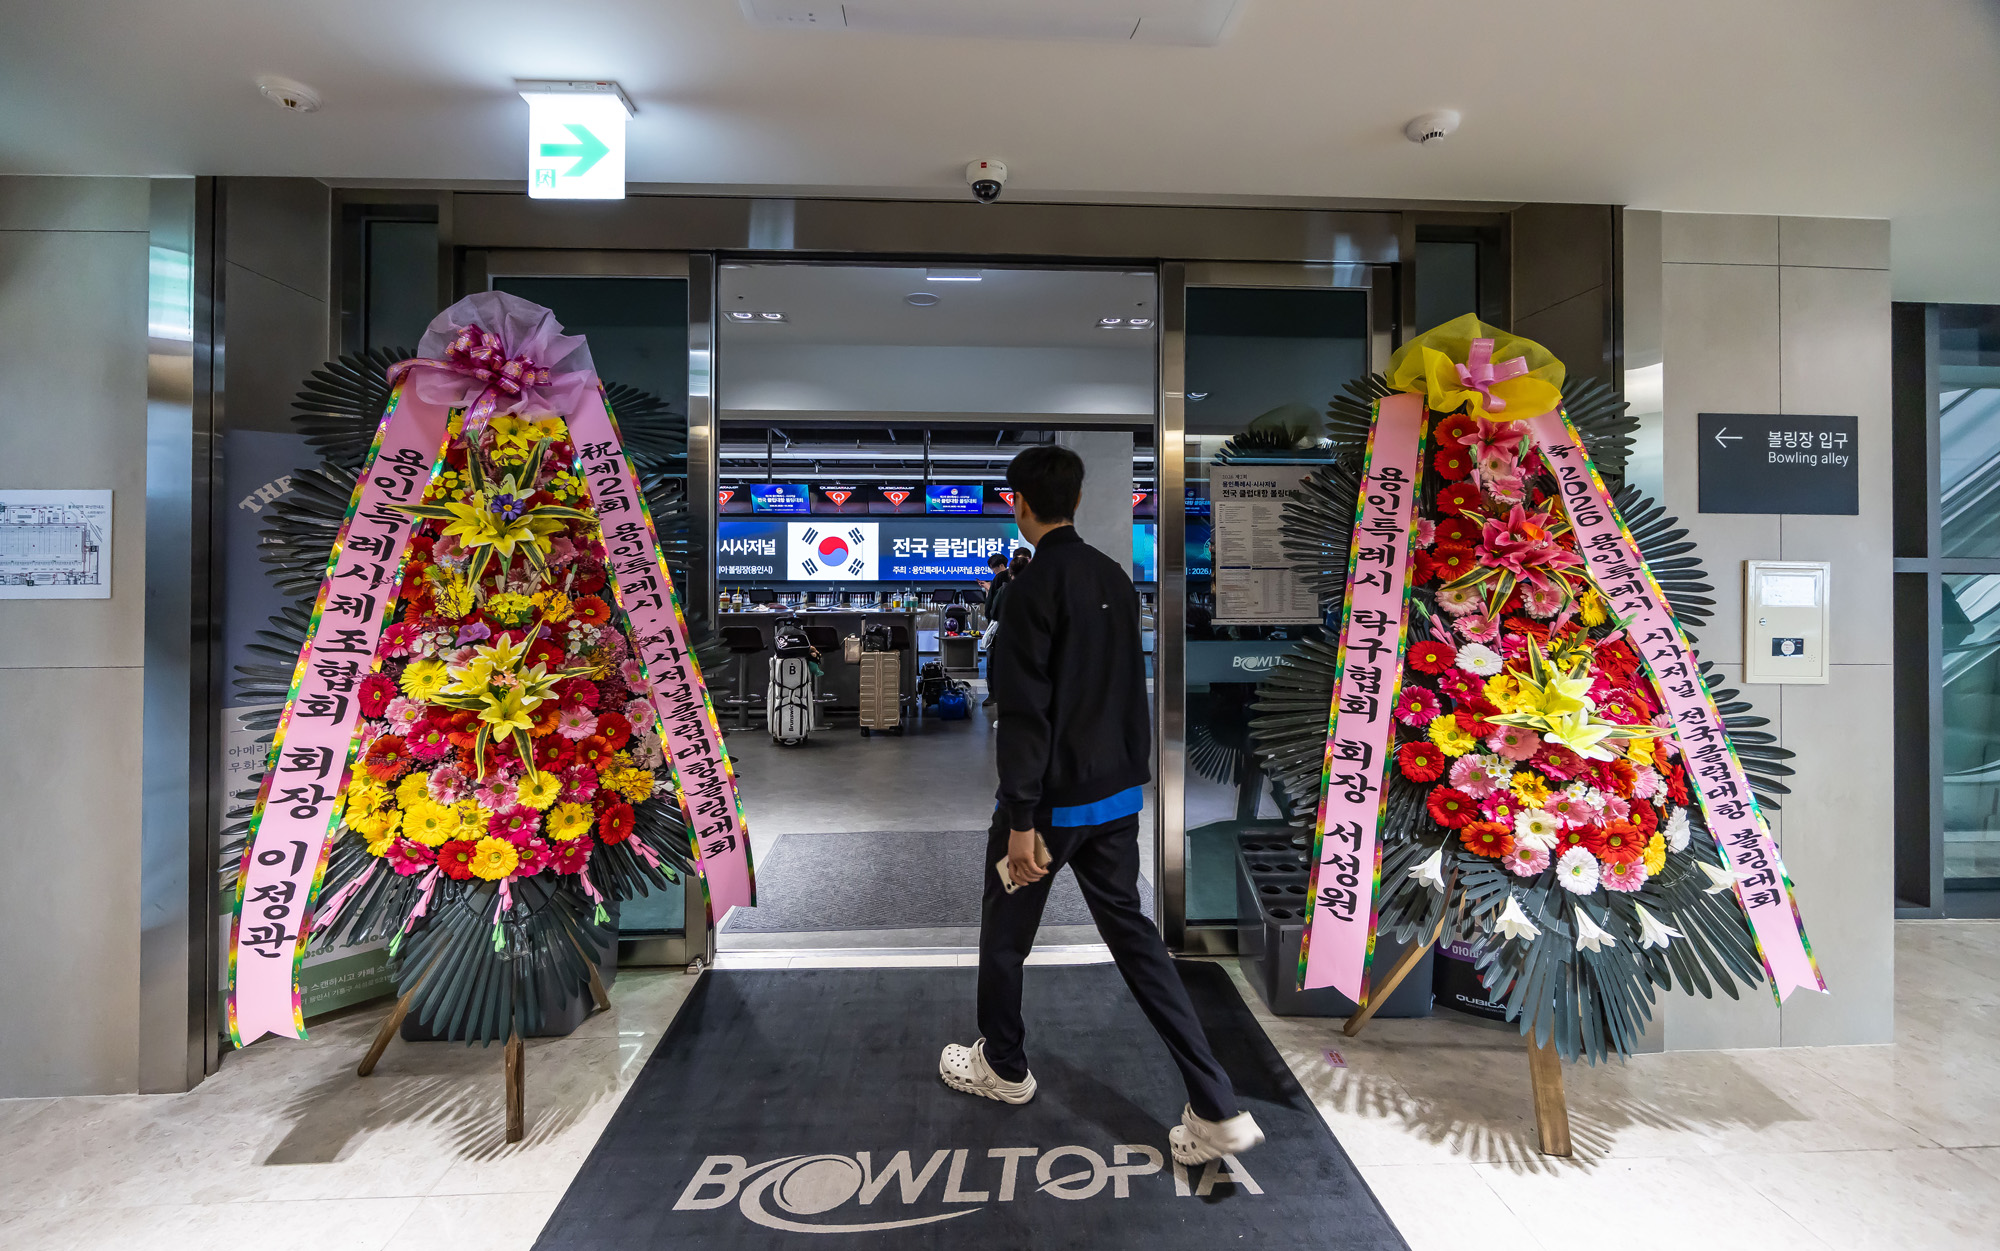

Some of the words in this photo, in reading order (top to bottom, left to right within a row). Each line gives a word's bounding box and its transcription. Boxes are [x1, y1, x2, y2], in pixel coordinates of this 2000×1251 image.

[1767, 430, 1813, 449] 볼링장
[1819, 432, 1849, 450] 입구
[1767, 451, 1818, 467] Bowling
[1820, 451, 1849, 467] alley
[1222, 489, 1237, 498] 전국
[1559, 466, 1604, 527] 2026
[719, 538, 776, 556] 시사저널
[892, 537, 929, 558] 전국
[932, 537, 1004, 558] 클럽대항
[1353, 466, 1410, 596] 용인특례시
[295, 448, 430, 726] 용인특례시체조협회
[892, 565, 907, 575] 주최
[789, 664, 797, 675] B
[1232, 656, 1296, 671] BOWLT
[1339, 609, 1398, 724] 탁구협회
[228, 743, 272, 758] 아메리
[1328, 738, 1378, 804] 회장
[268, 745, 336, 820] 회장
[1317, 820, 1363, 922] 서성원
[240, 840, 308, 959] 이정관
[671, 1144, 1265, 1226] BOWLTOPIA
